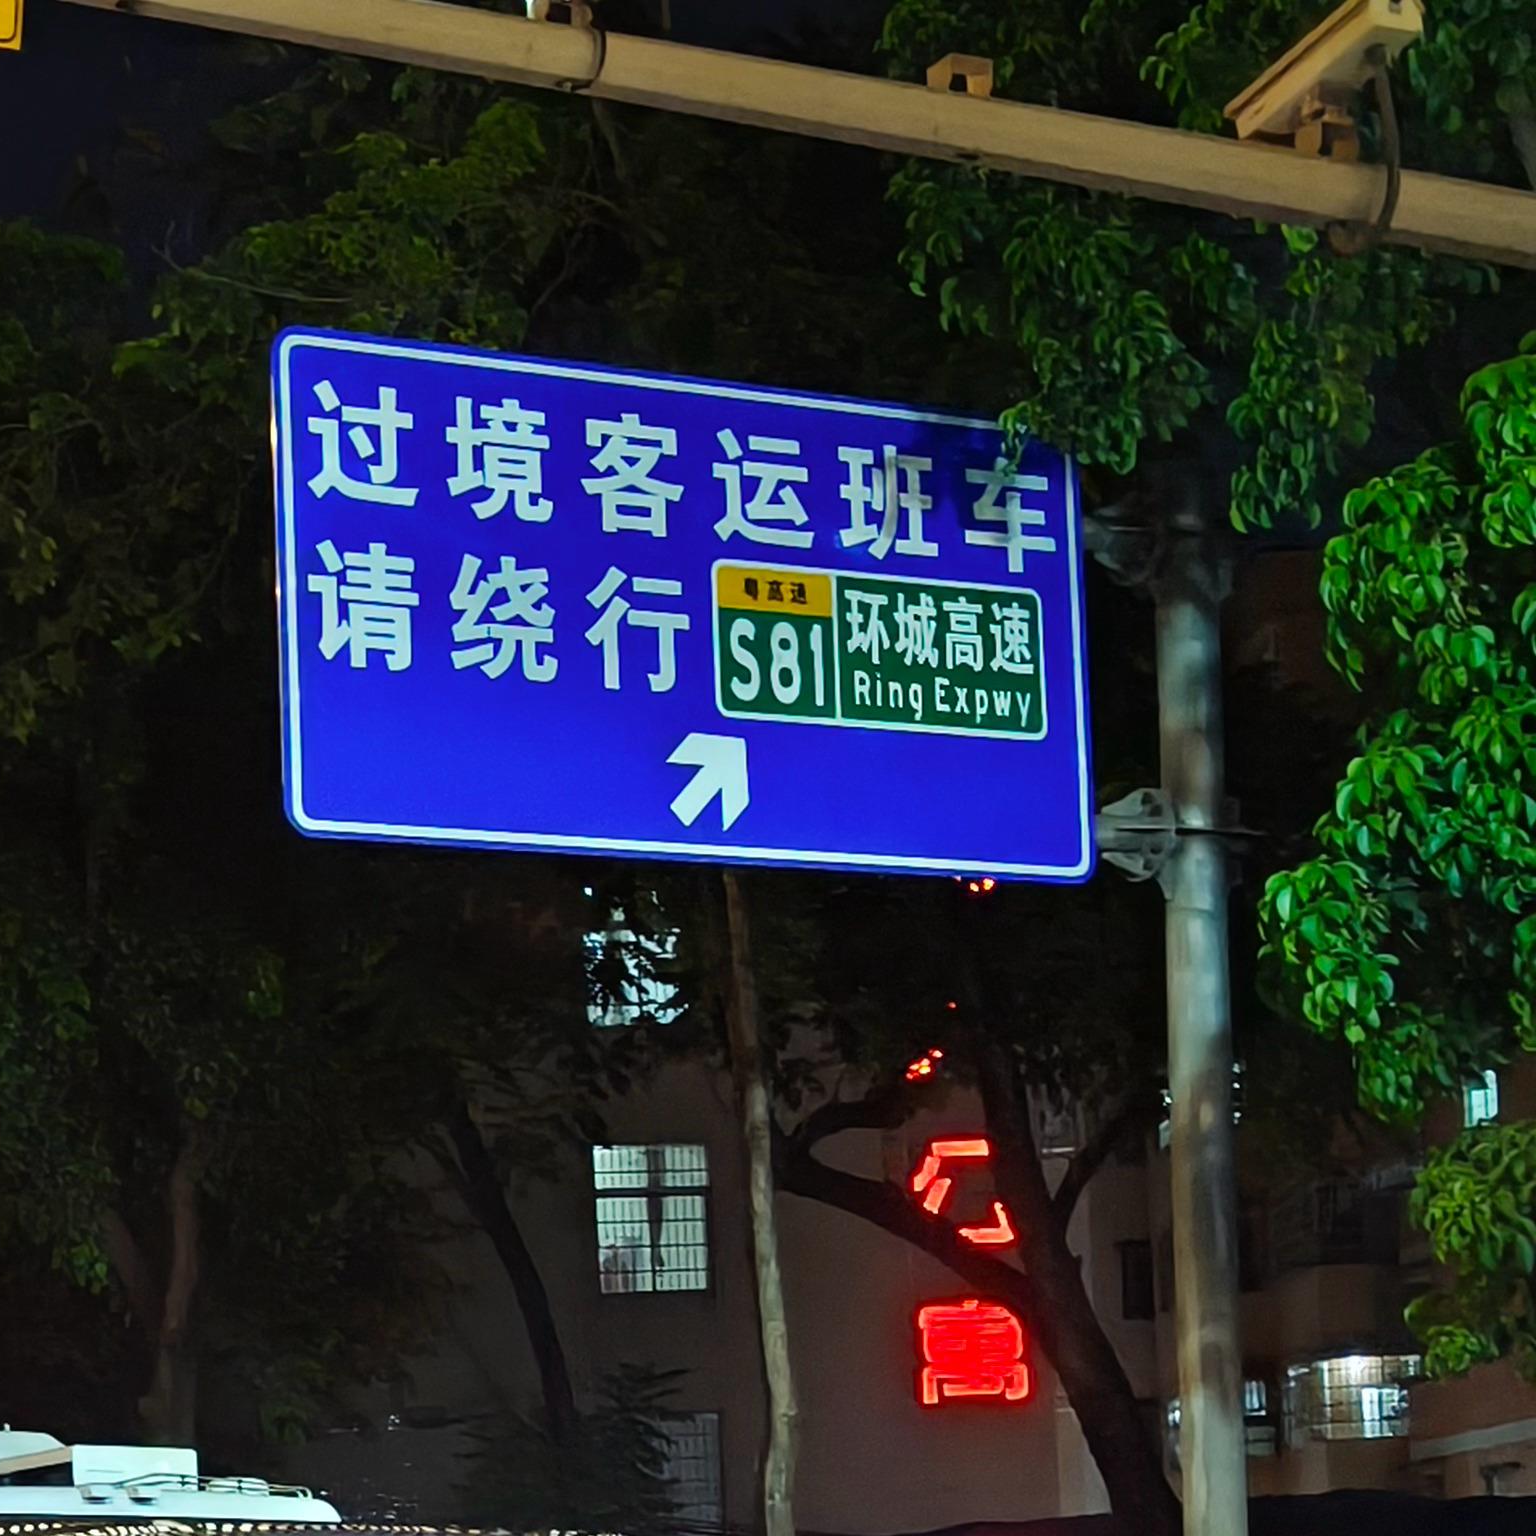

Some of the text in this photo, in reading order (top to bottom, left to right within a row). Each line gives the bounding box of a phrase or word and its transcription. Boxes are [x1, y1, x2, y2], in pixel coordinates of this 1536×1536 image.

[306, 378, 1058, 575] 过境客运班车
[307, 539, 691, 693] 请绕行
[729, 616, 825, 706] S81
[844, 588, 1035, 675] 环城高速
[853, 669, 1031, 728] Ring Expwy
